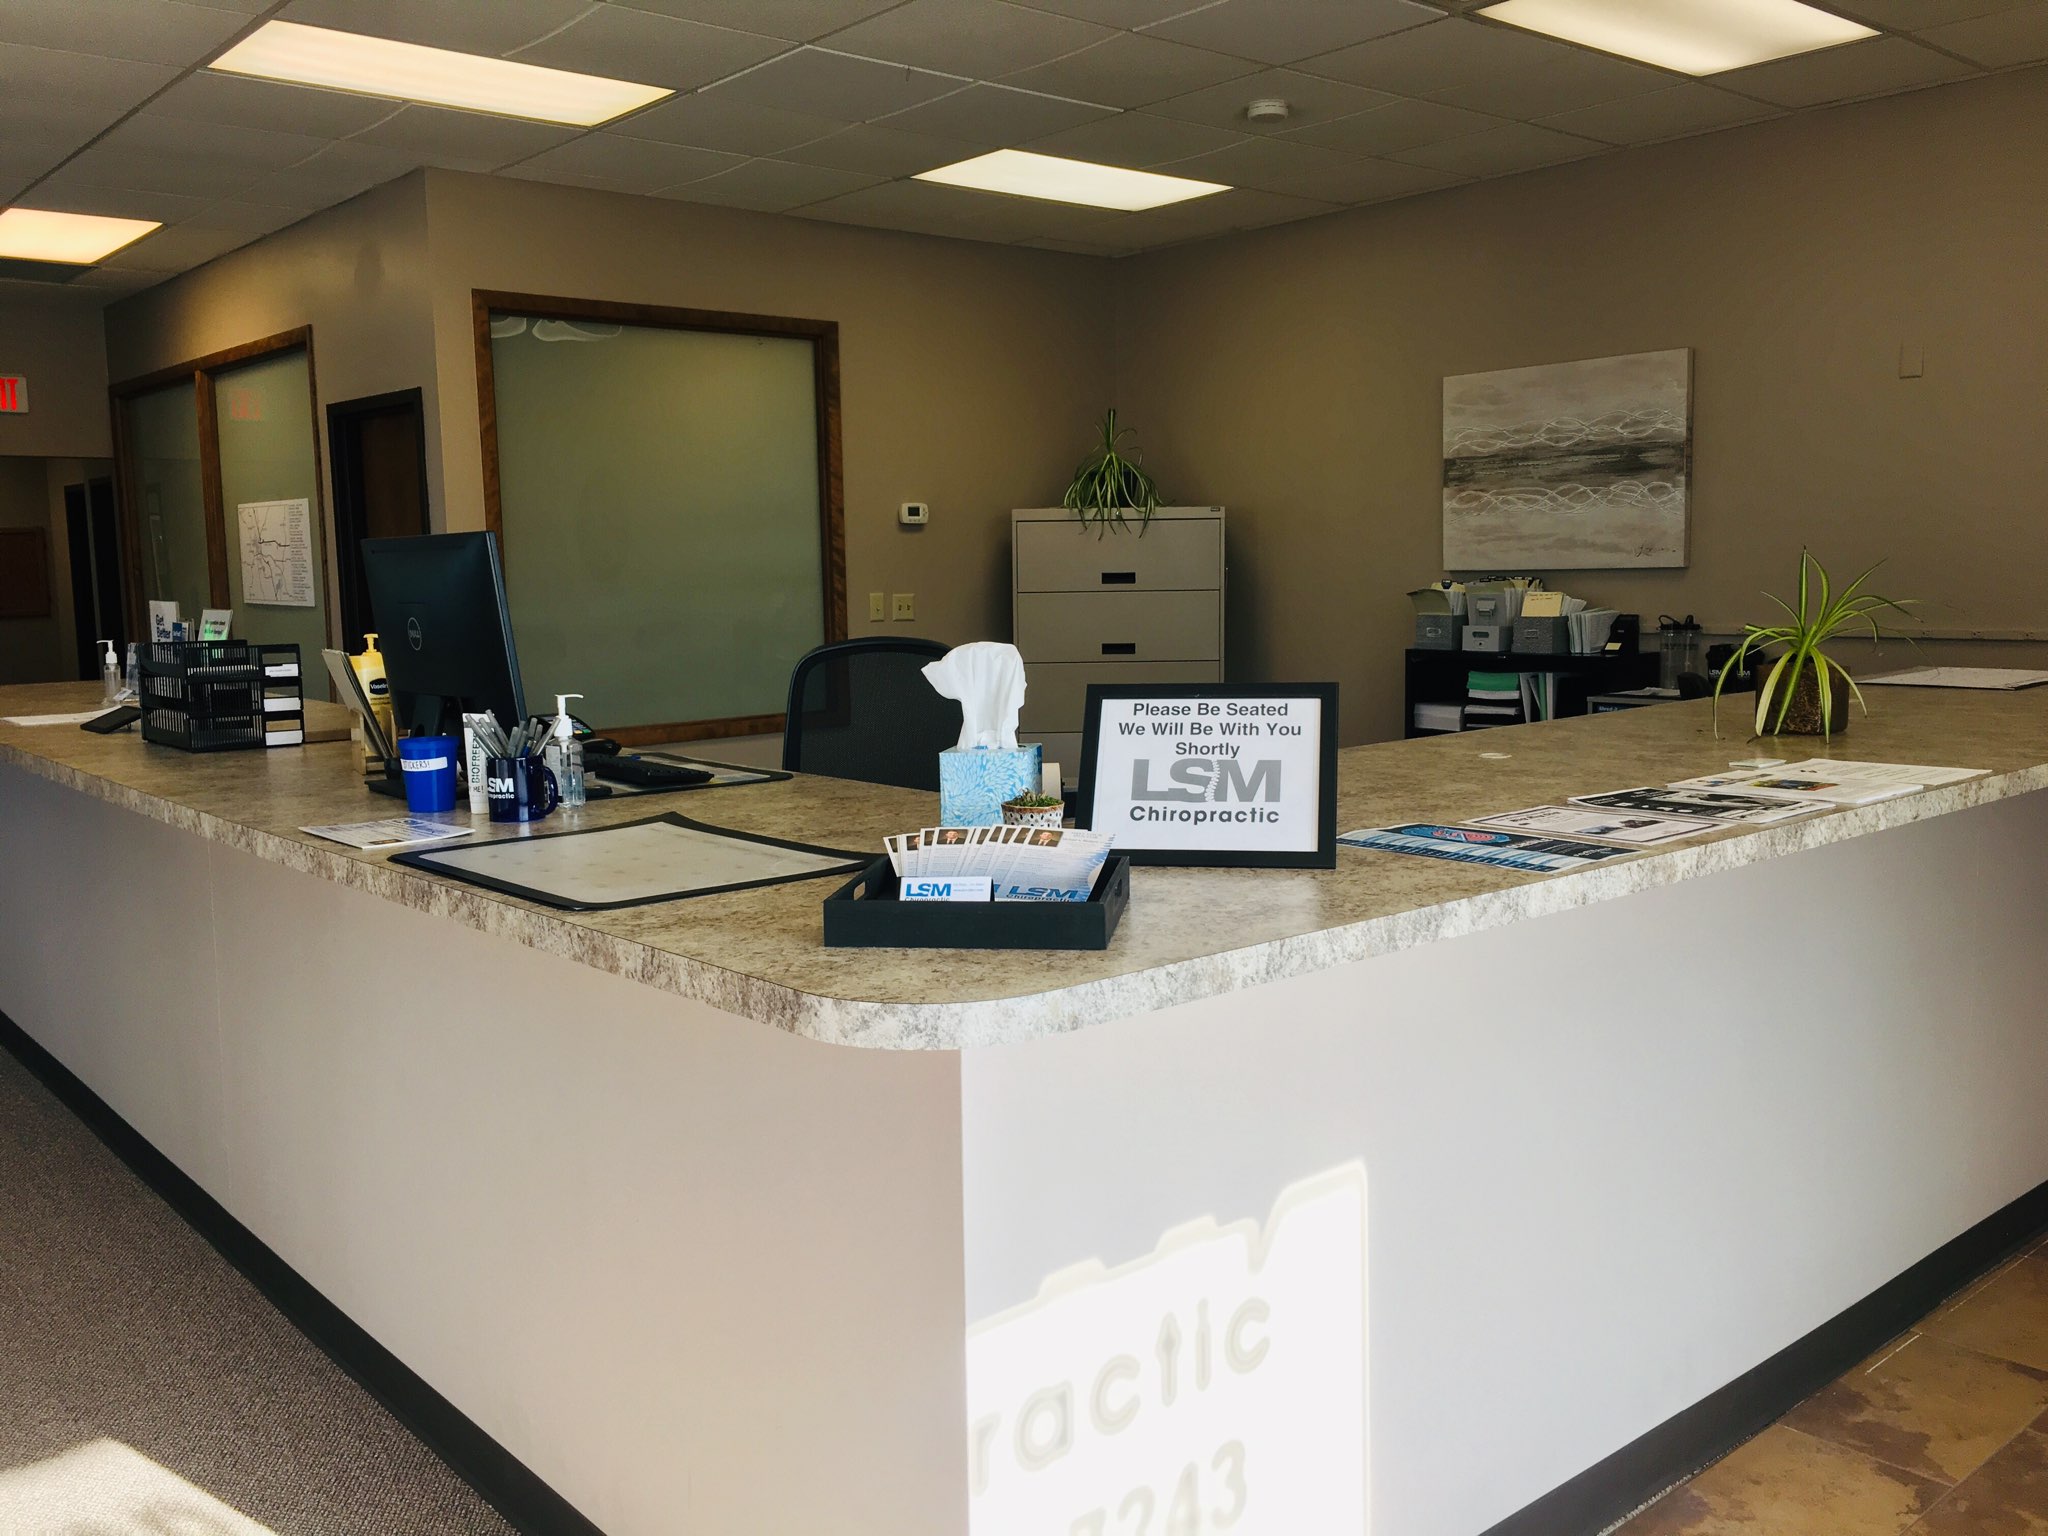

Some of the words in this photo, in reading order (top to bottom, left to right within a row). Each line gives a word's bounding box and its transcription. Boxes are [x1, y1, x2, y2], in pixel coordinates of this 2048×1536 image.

[1132, 702, 1191, 716] Please
[1197, 702, 1221, 716] Be
[1226, 702, 1288, 716] Seated
[1118, 722, 1146, 736] We
[1151, 722, 1184, 736] Will
[1190, 722, 1213, 736] Be
[1219, 722, 1260, 736] With
[1266, 722, 1302, 736] You
[1175, 741, 1240, 758] Shortly
[1131, 757, 1282, 803] LSM
[1129, 805, 1280, 825] Chiropractic
[905, 883, 951, 896] LSM
[1009, 885, 1079, 899] LSM
